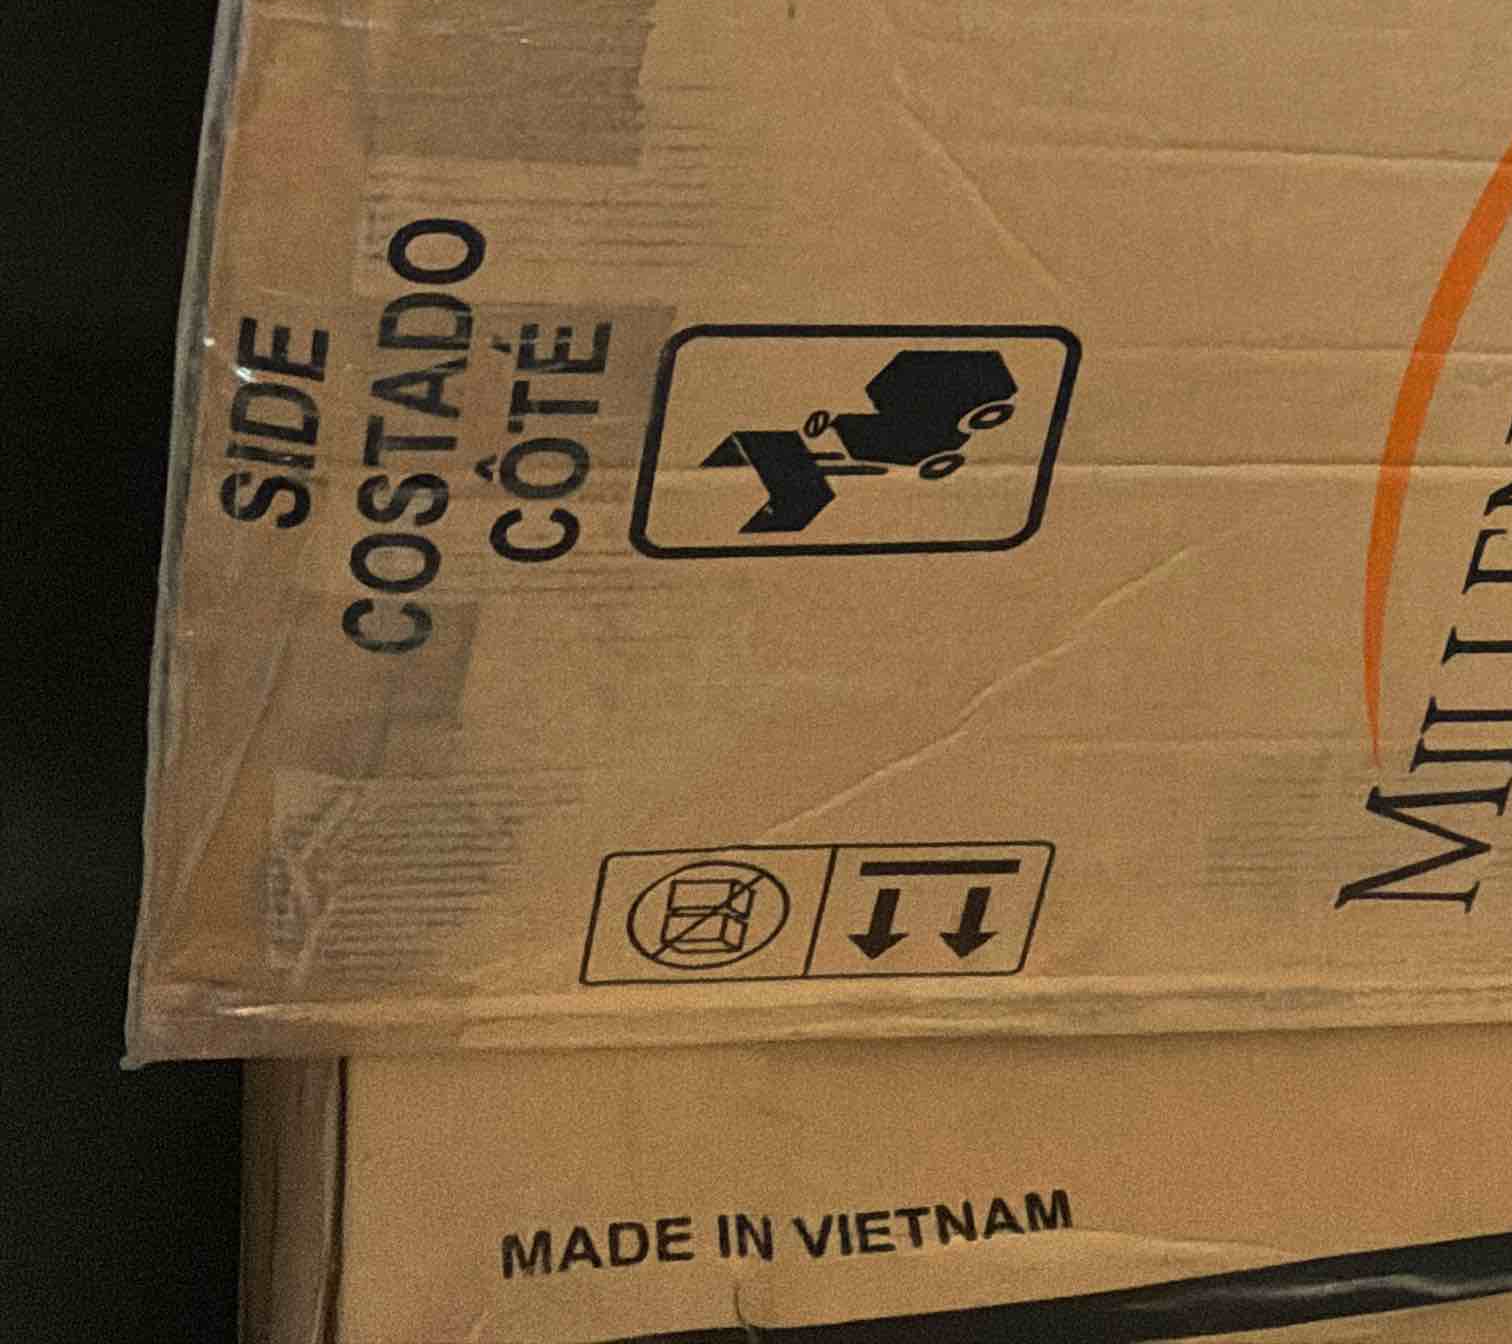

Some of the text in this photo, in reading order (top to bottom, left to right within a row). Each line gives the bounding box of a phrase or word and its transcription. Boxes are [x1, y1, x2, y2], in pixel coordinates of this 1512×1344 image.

[220, 315, 330, 530] SIDE
[341, 218, 487, 655] COSTADO
[474, 320, 612, 563] CÔTÉ
[501, 1187, 1075, 1280] MADE IN VIETNAM
